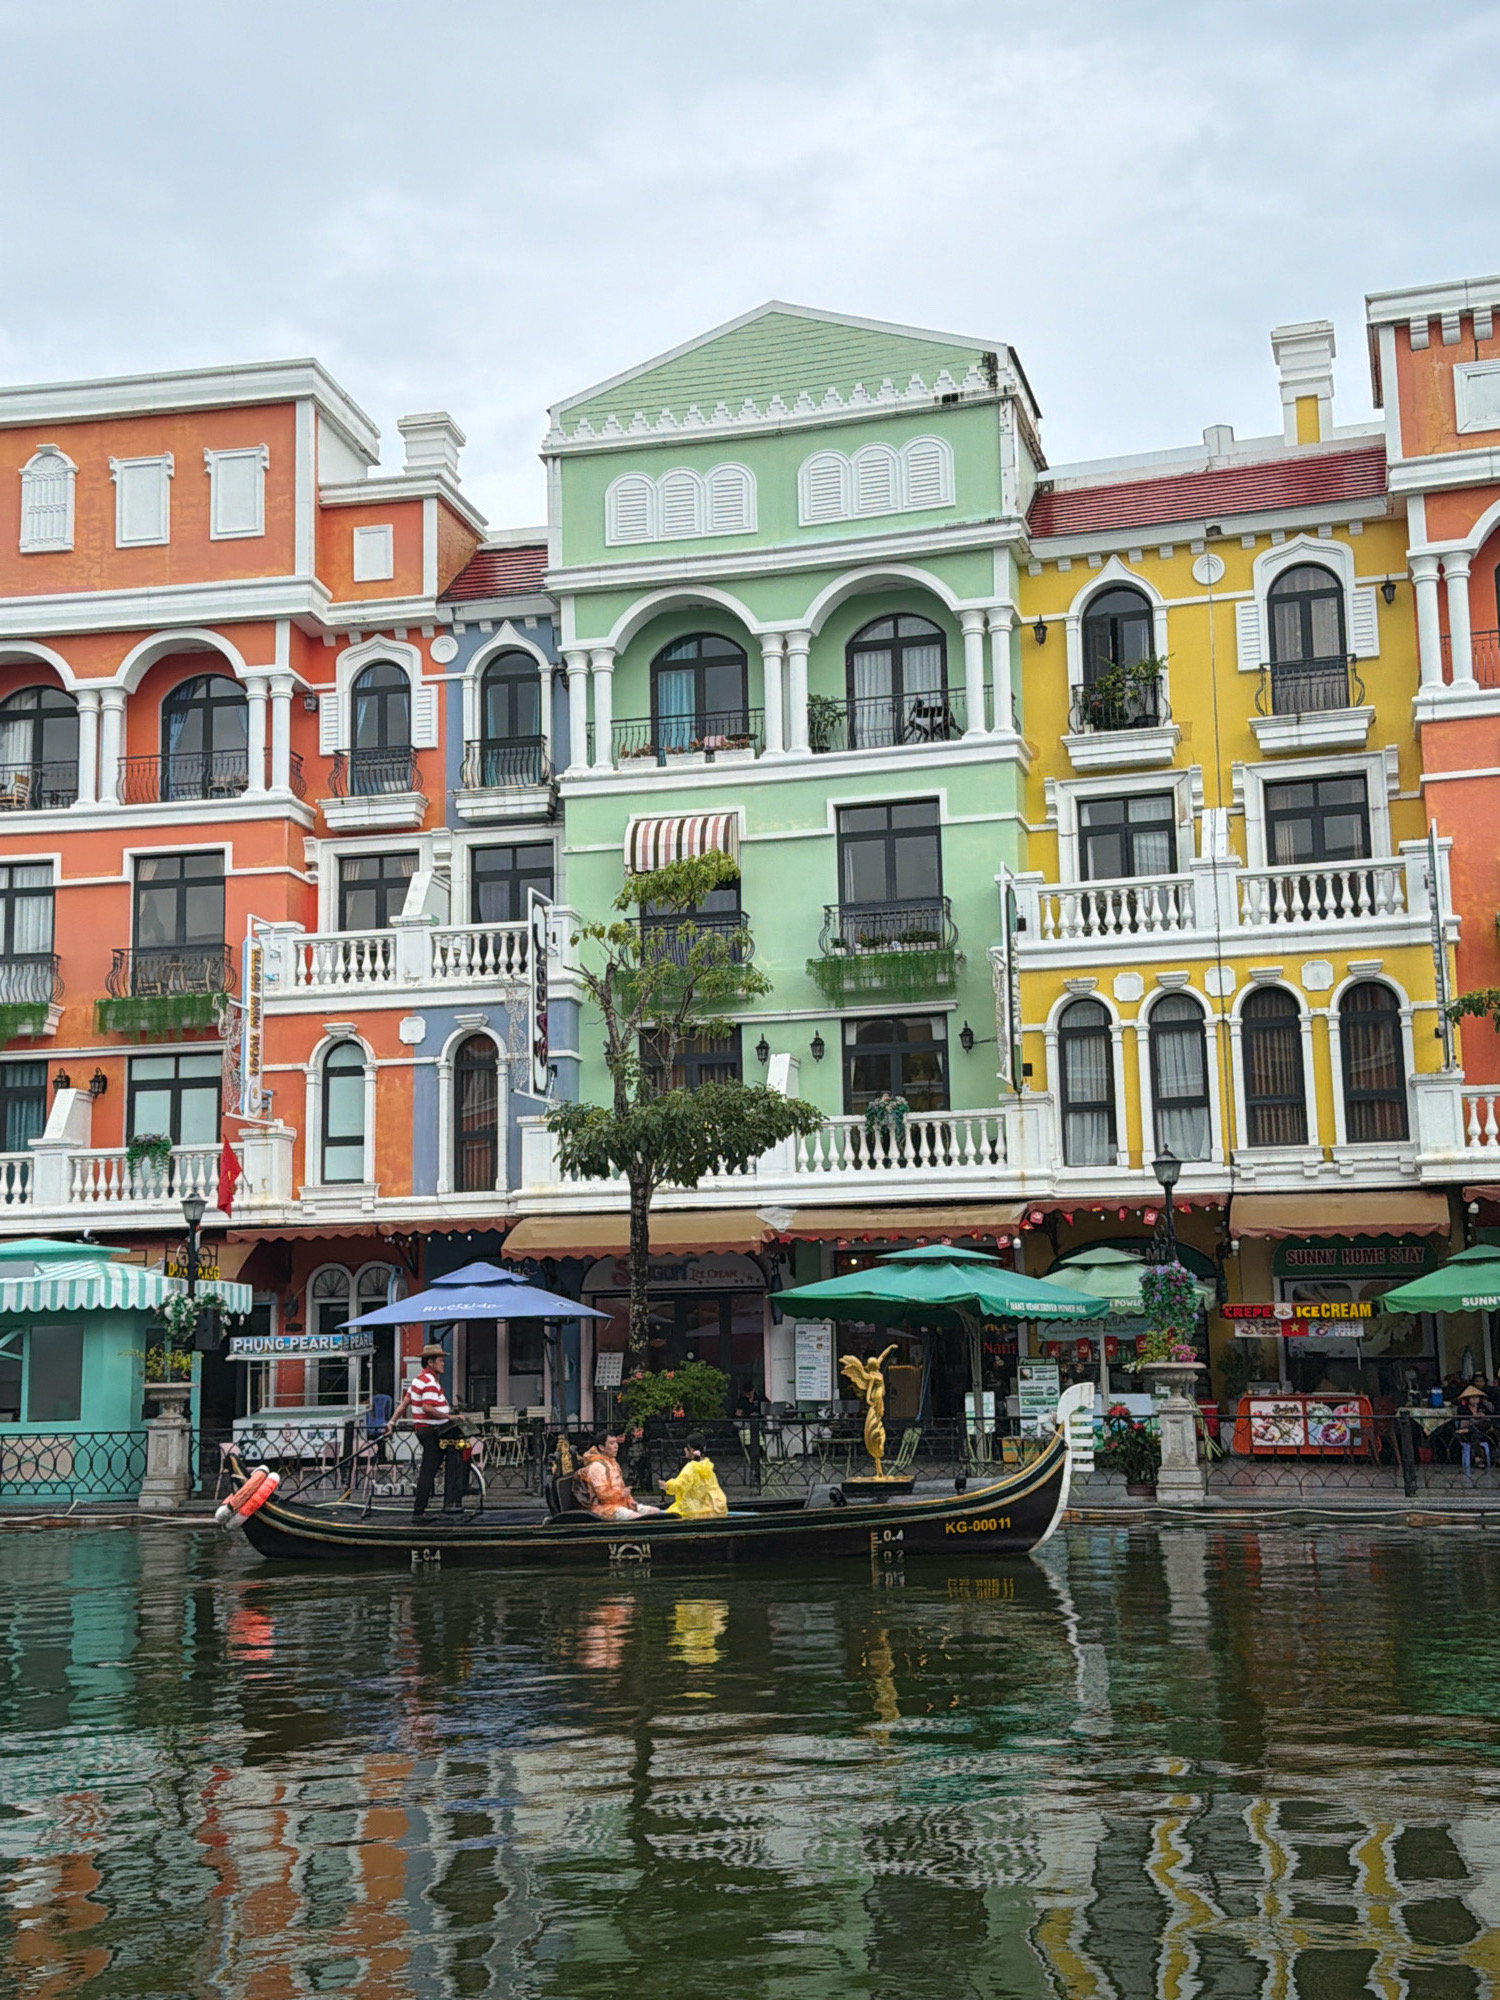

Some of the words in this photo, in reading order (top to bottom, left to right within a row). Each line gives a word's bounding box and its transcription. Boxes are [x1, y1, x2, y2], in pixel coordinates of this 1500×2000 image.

[1286, 1249, 1337, 1266] SUNNY
[1342, 1248, 1385, 1265] HOME
[1389, 1246, 1425, 1264] STAY
[1223, 1305, 1272, 1319] CREPE
[1296, 1305, 1320, 1318] ICE
[1321, 1303, 1372, 1318] CREAM
[290, 1336, 338, 1350] PEARL
[351, 1332, 373, 1348] PEARL
[945, 1517, 1011, 1534] KG-00011
[883, 1529, 904, 1542] 0.4
